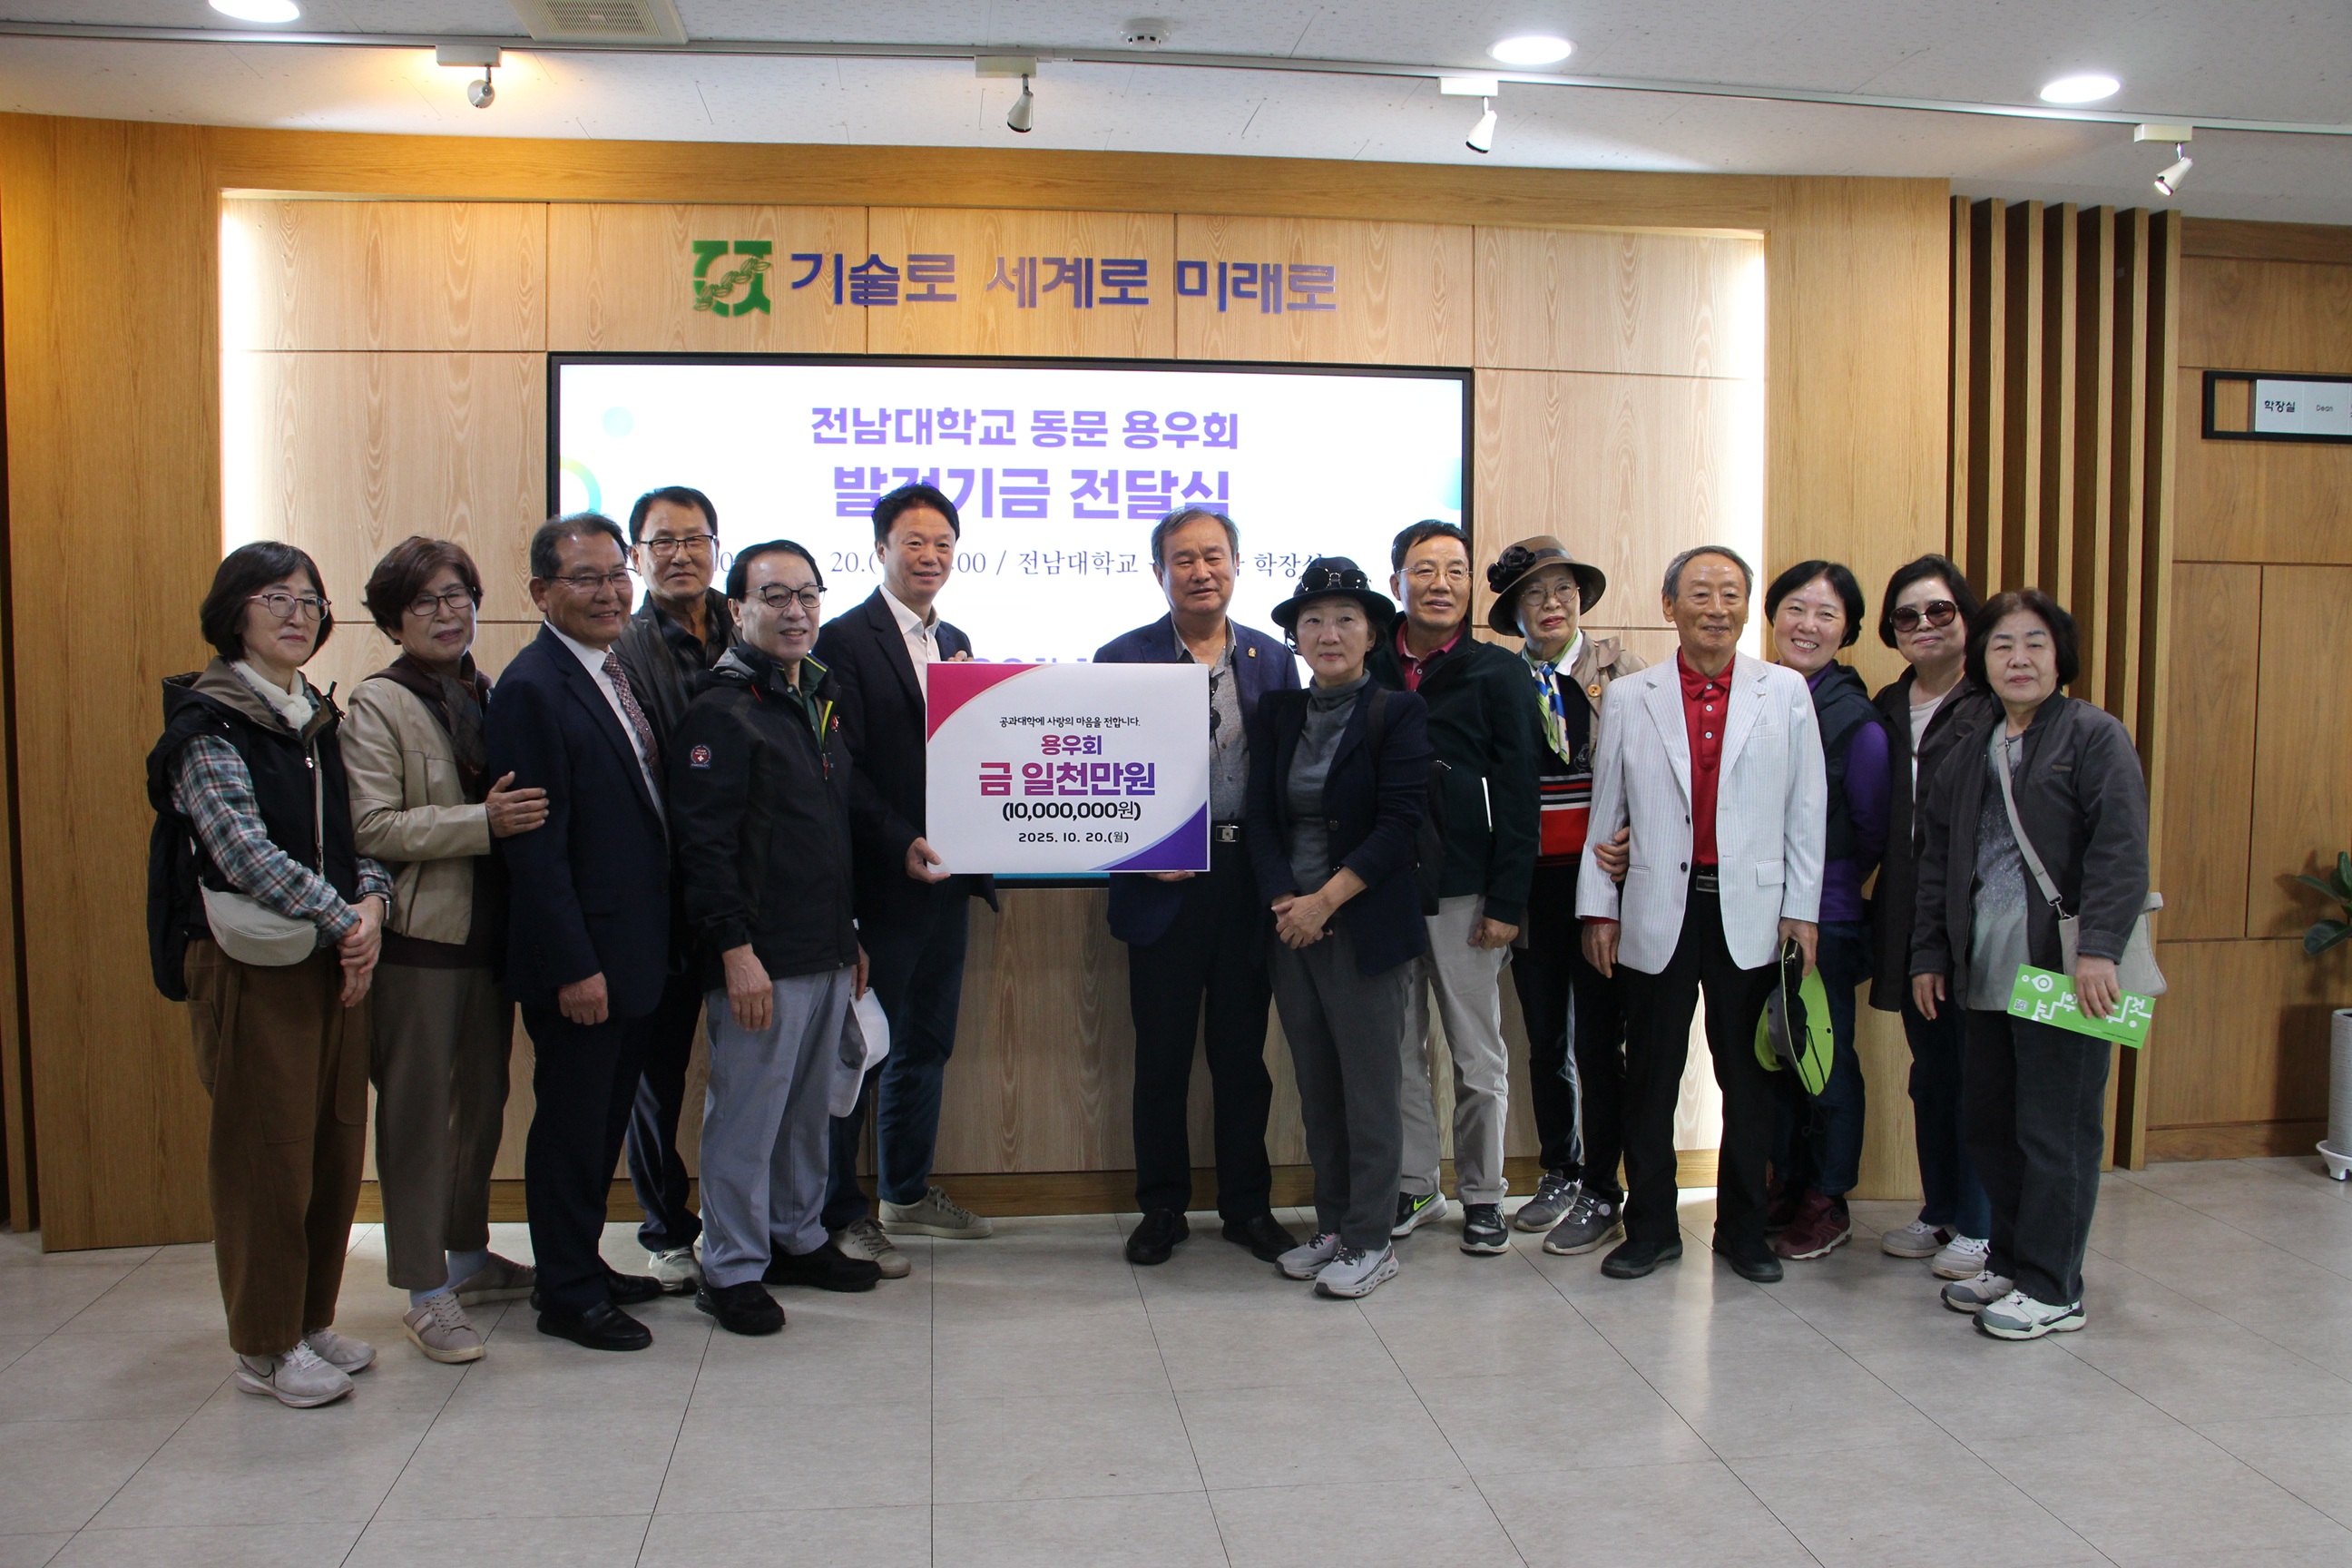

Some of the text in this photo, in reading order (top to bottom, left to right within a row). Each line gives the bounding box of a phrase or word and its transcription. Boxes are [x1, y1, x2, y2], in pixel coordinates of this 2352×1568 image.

[789, 253, 1338, 314] 기술로 세계로 미래로
[2264, 399, 2296, 413] 학장실
[810, 407, 1239, 450] 전남대학교 동문 용우회
[1017, 549, 1139, 576] 전남대학교
[999, 716, 1142, 729] 공과대학에 사랑의 마음을 전합니다.
[1041, 734, 1102, 756] 용우회
[978, 761, 1156, 797] 금 일천만원
[1002, 800, 1142, 822] (10,000,000원)
[1018, 830, 1130, 845] 2025. 10. 20.(월)
